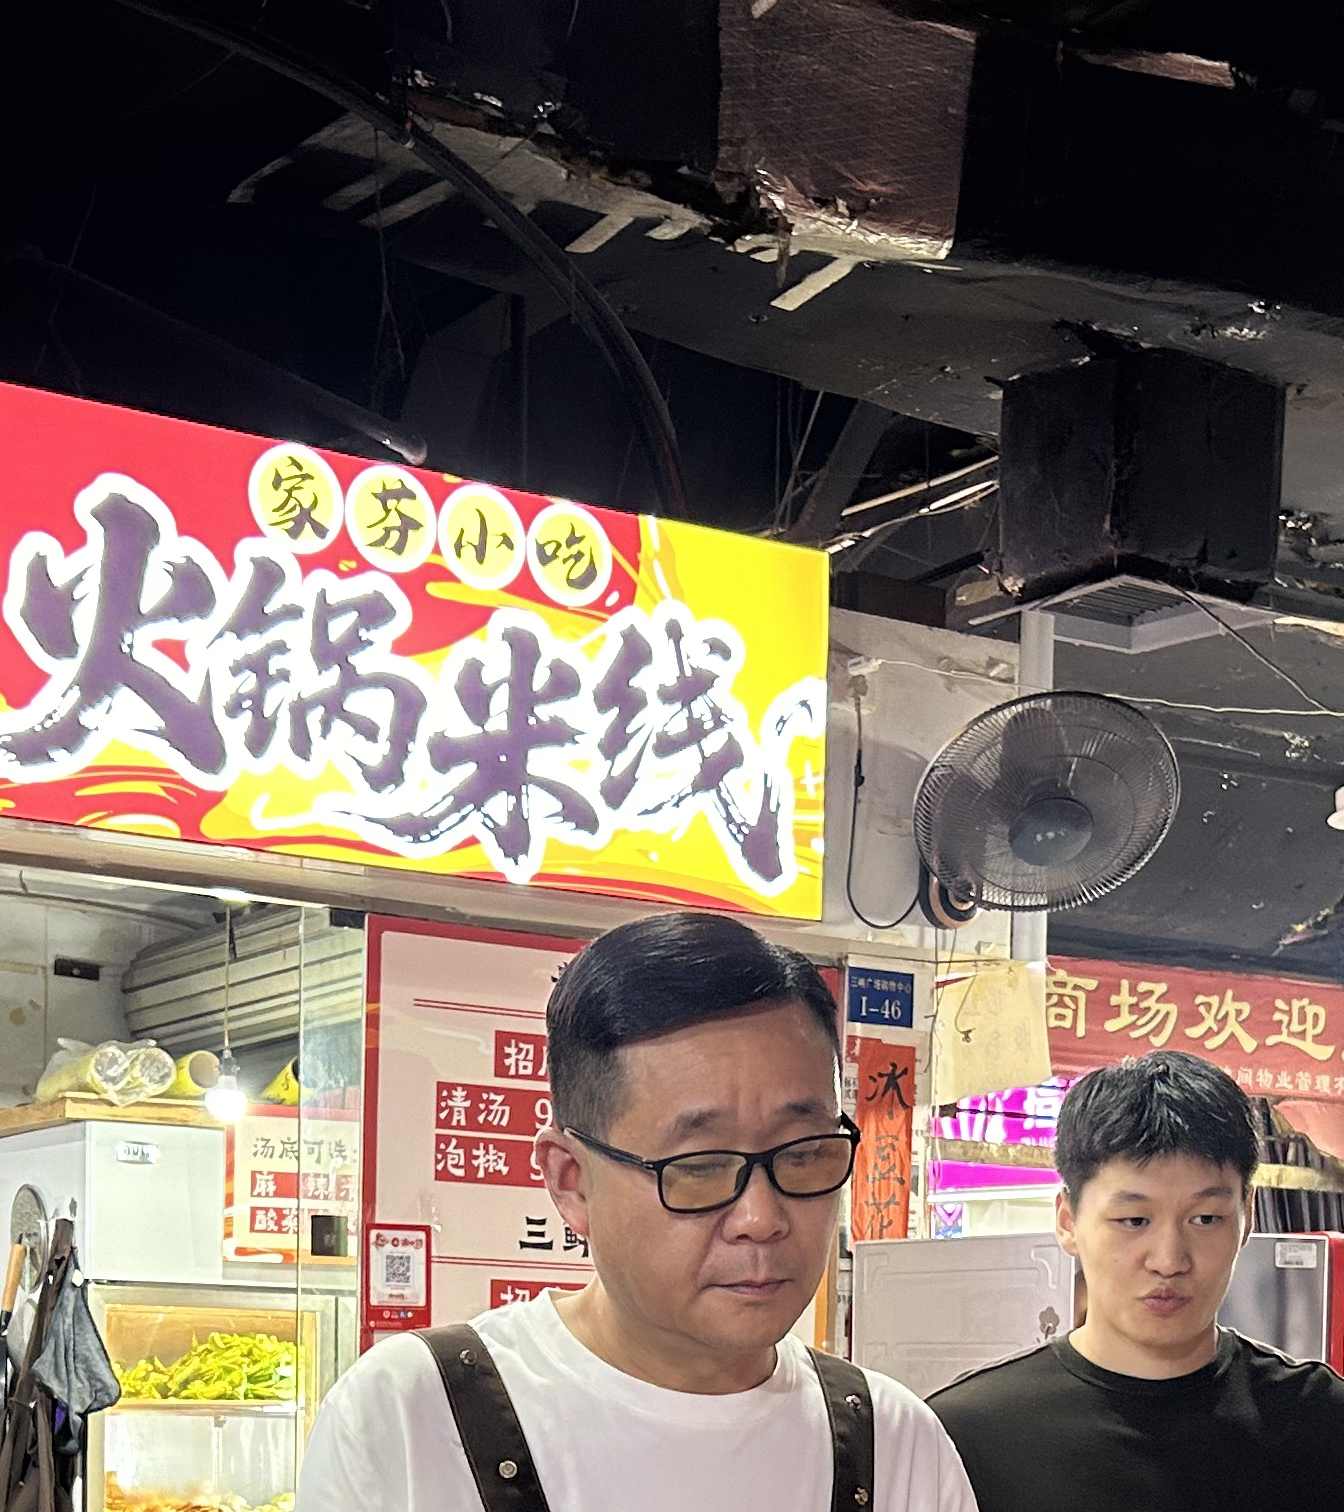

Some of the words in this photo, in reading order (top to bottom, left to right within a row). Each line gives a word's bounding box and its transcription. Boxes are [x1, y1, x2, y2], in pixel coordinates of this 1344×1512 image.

[268, 456, 598, 590] 家芬小吃
[504, 1038, 548, 1076] 招
[439, 1086, 511, 1127] 清汤
[436, 1138, 510, 1179] 泡椒
